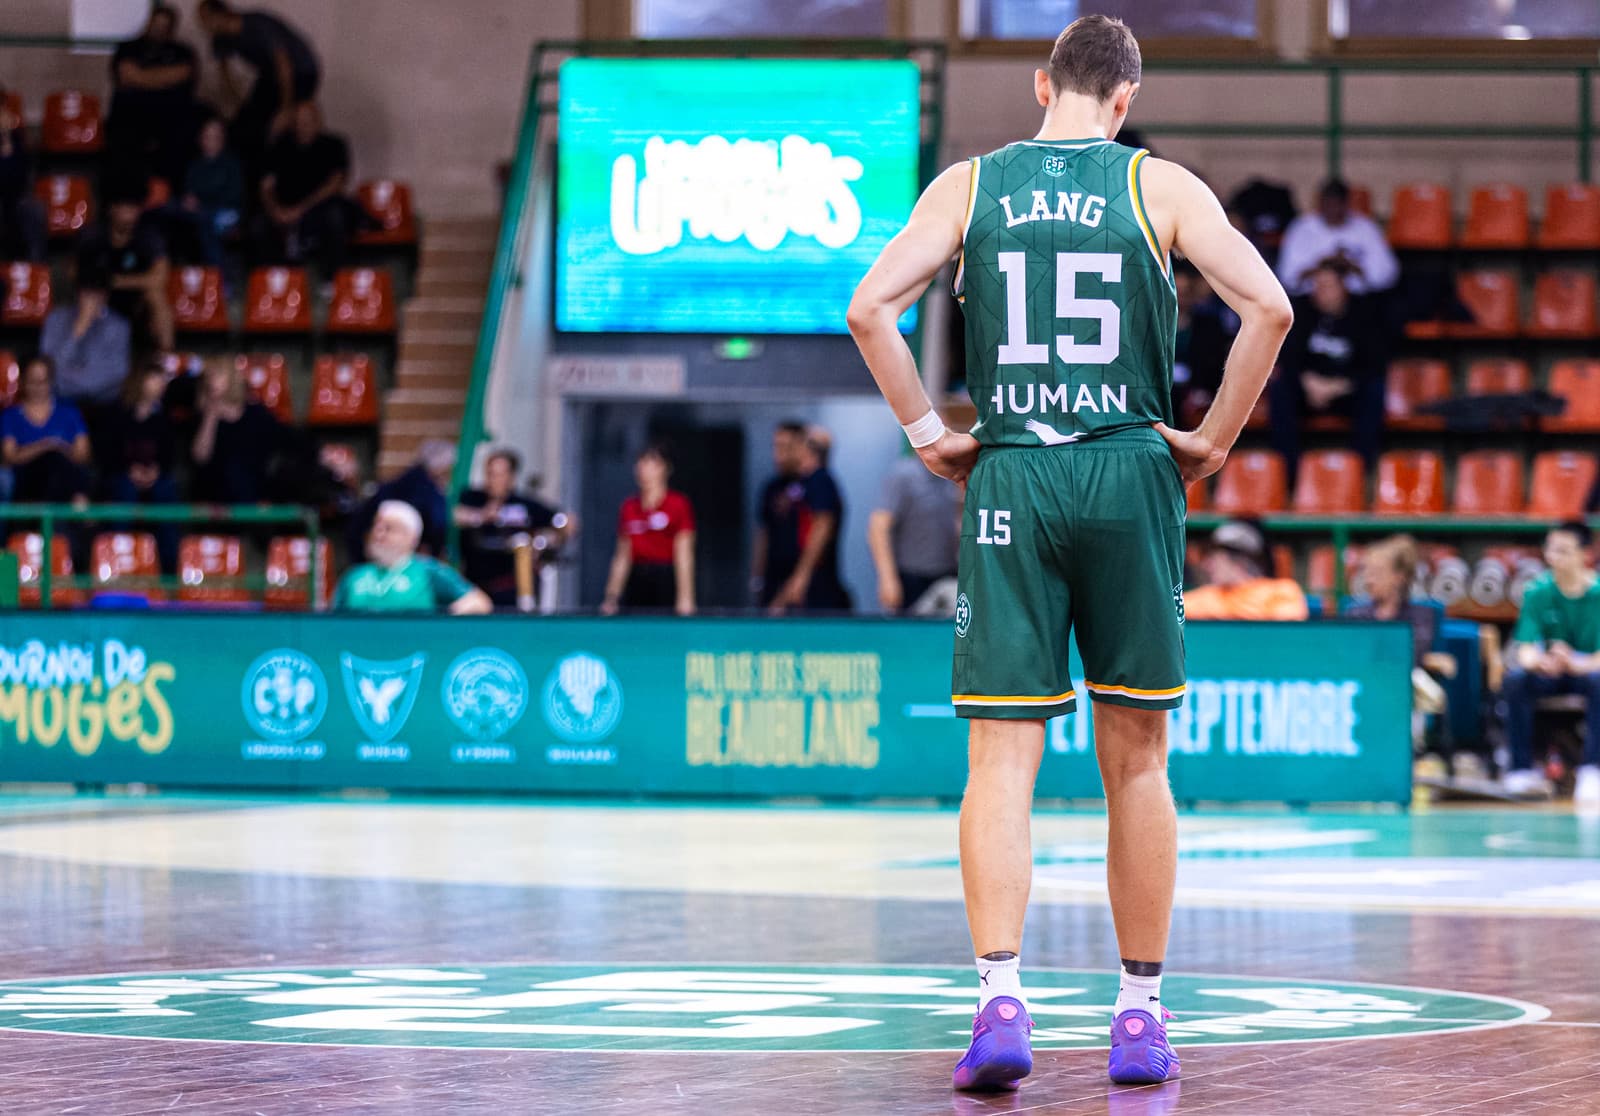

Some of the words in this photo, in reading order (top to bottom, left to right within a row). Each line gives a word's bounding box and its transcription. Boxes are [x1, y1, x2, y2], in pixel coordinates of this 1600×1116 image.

[1045, 156, 1065, 171] CSP
[999, 190, 1106, 228] LANG
[997, 251, 1123, 365] 15
[976, 508, 1012, 546] 15
